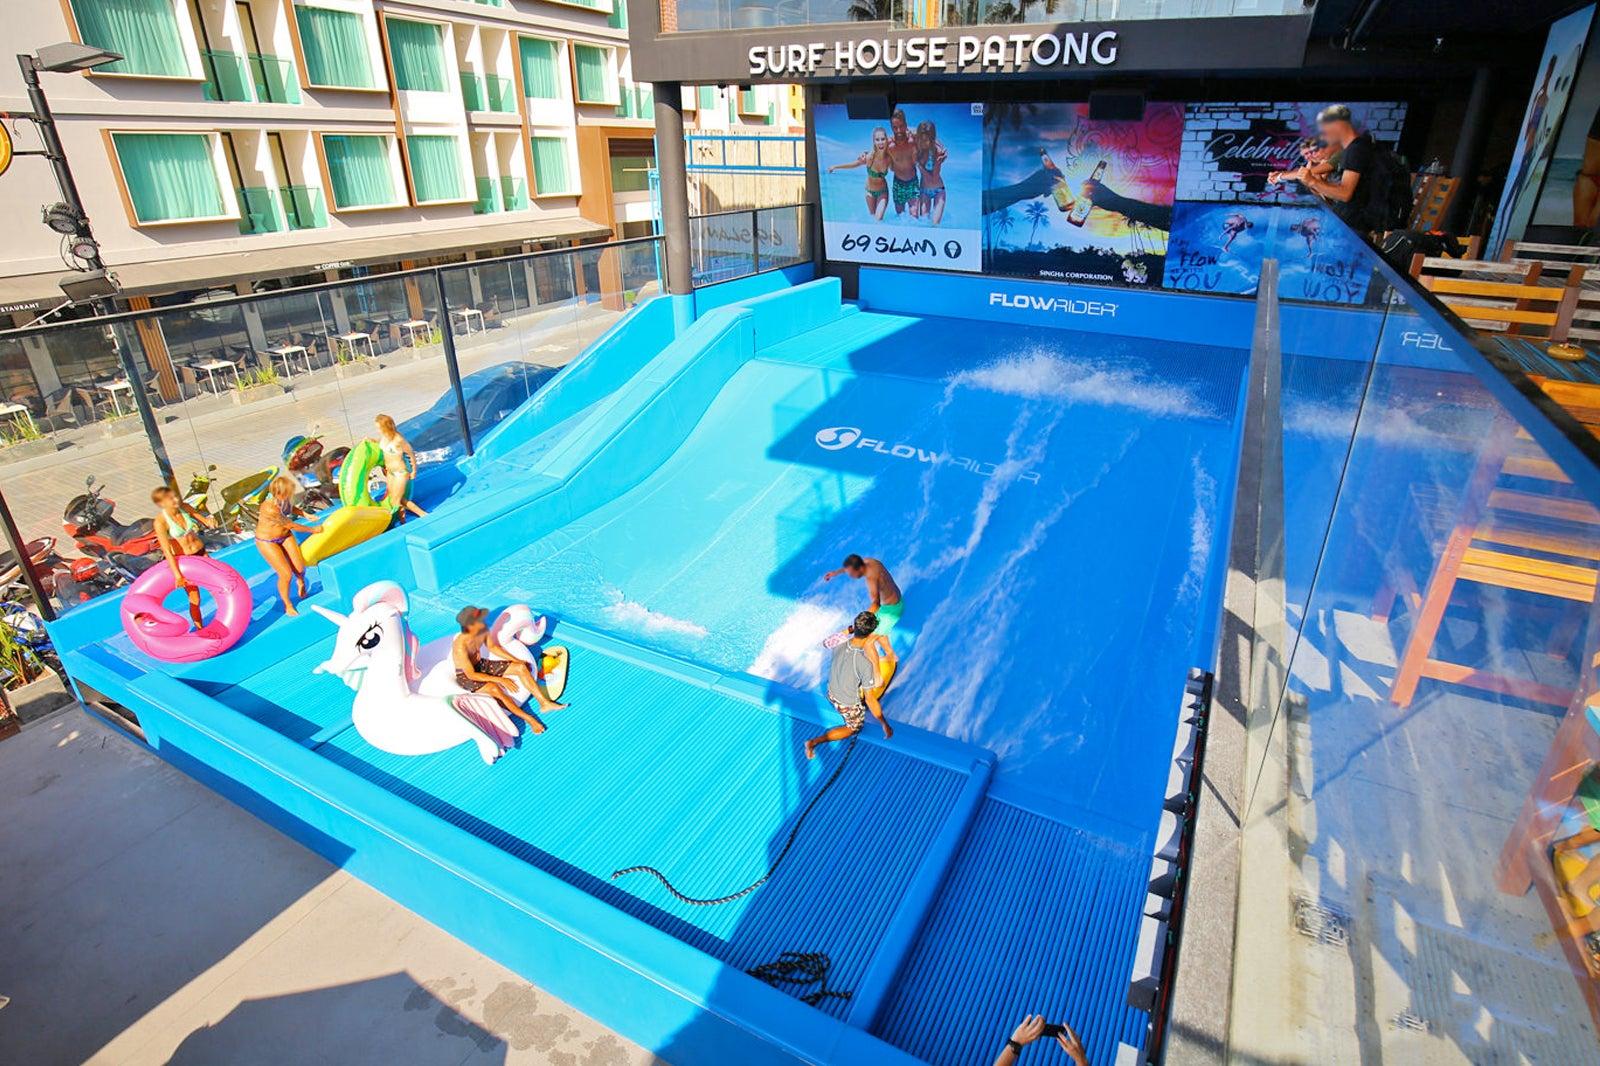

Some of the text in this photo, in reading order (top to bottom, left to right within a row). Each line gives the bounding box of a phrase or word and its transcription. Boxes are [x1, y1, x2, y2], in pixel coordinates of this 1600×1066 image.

[748, 31, 1119, 76] SURF HOUSE PATONG
[841, 233, 938, 257] 69 SLAM
[1039, 269, 1114, 282] SINGHA CORPORATION
[989, 291, 1119, 318] FLOWRIDER
[856, 437, 1041, 485] FLOWRIDR
